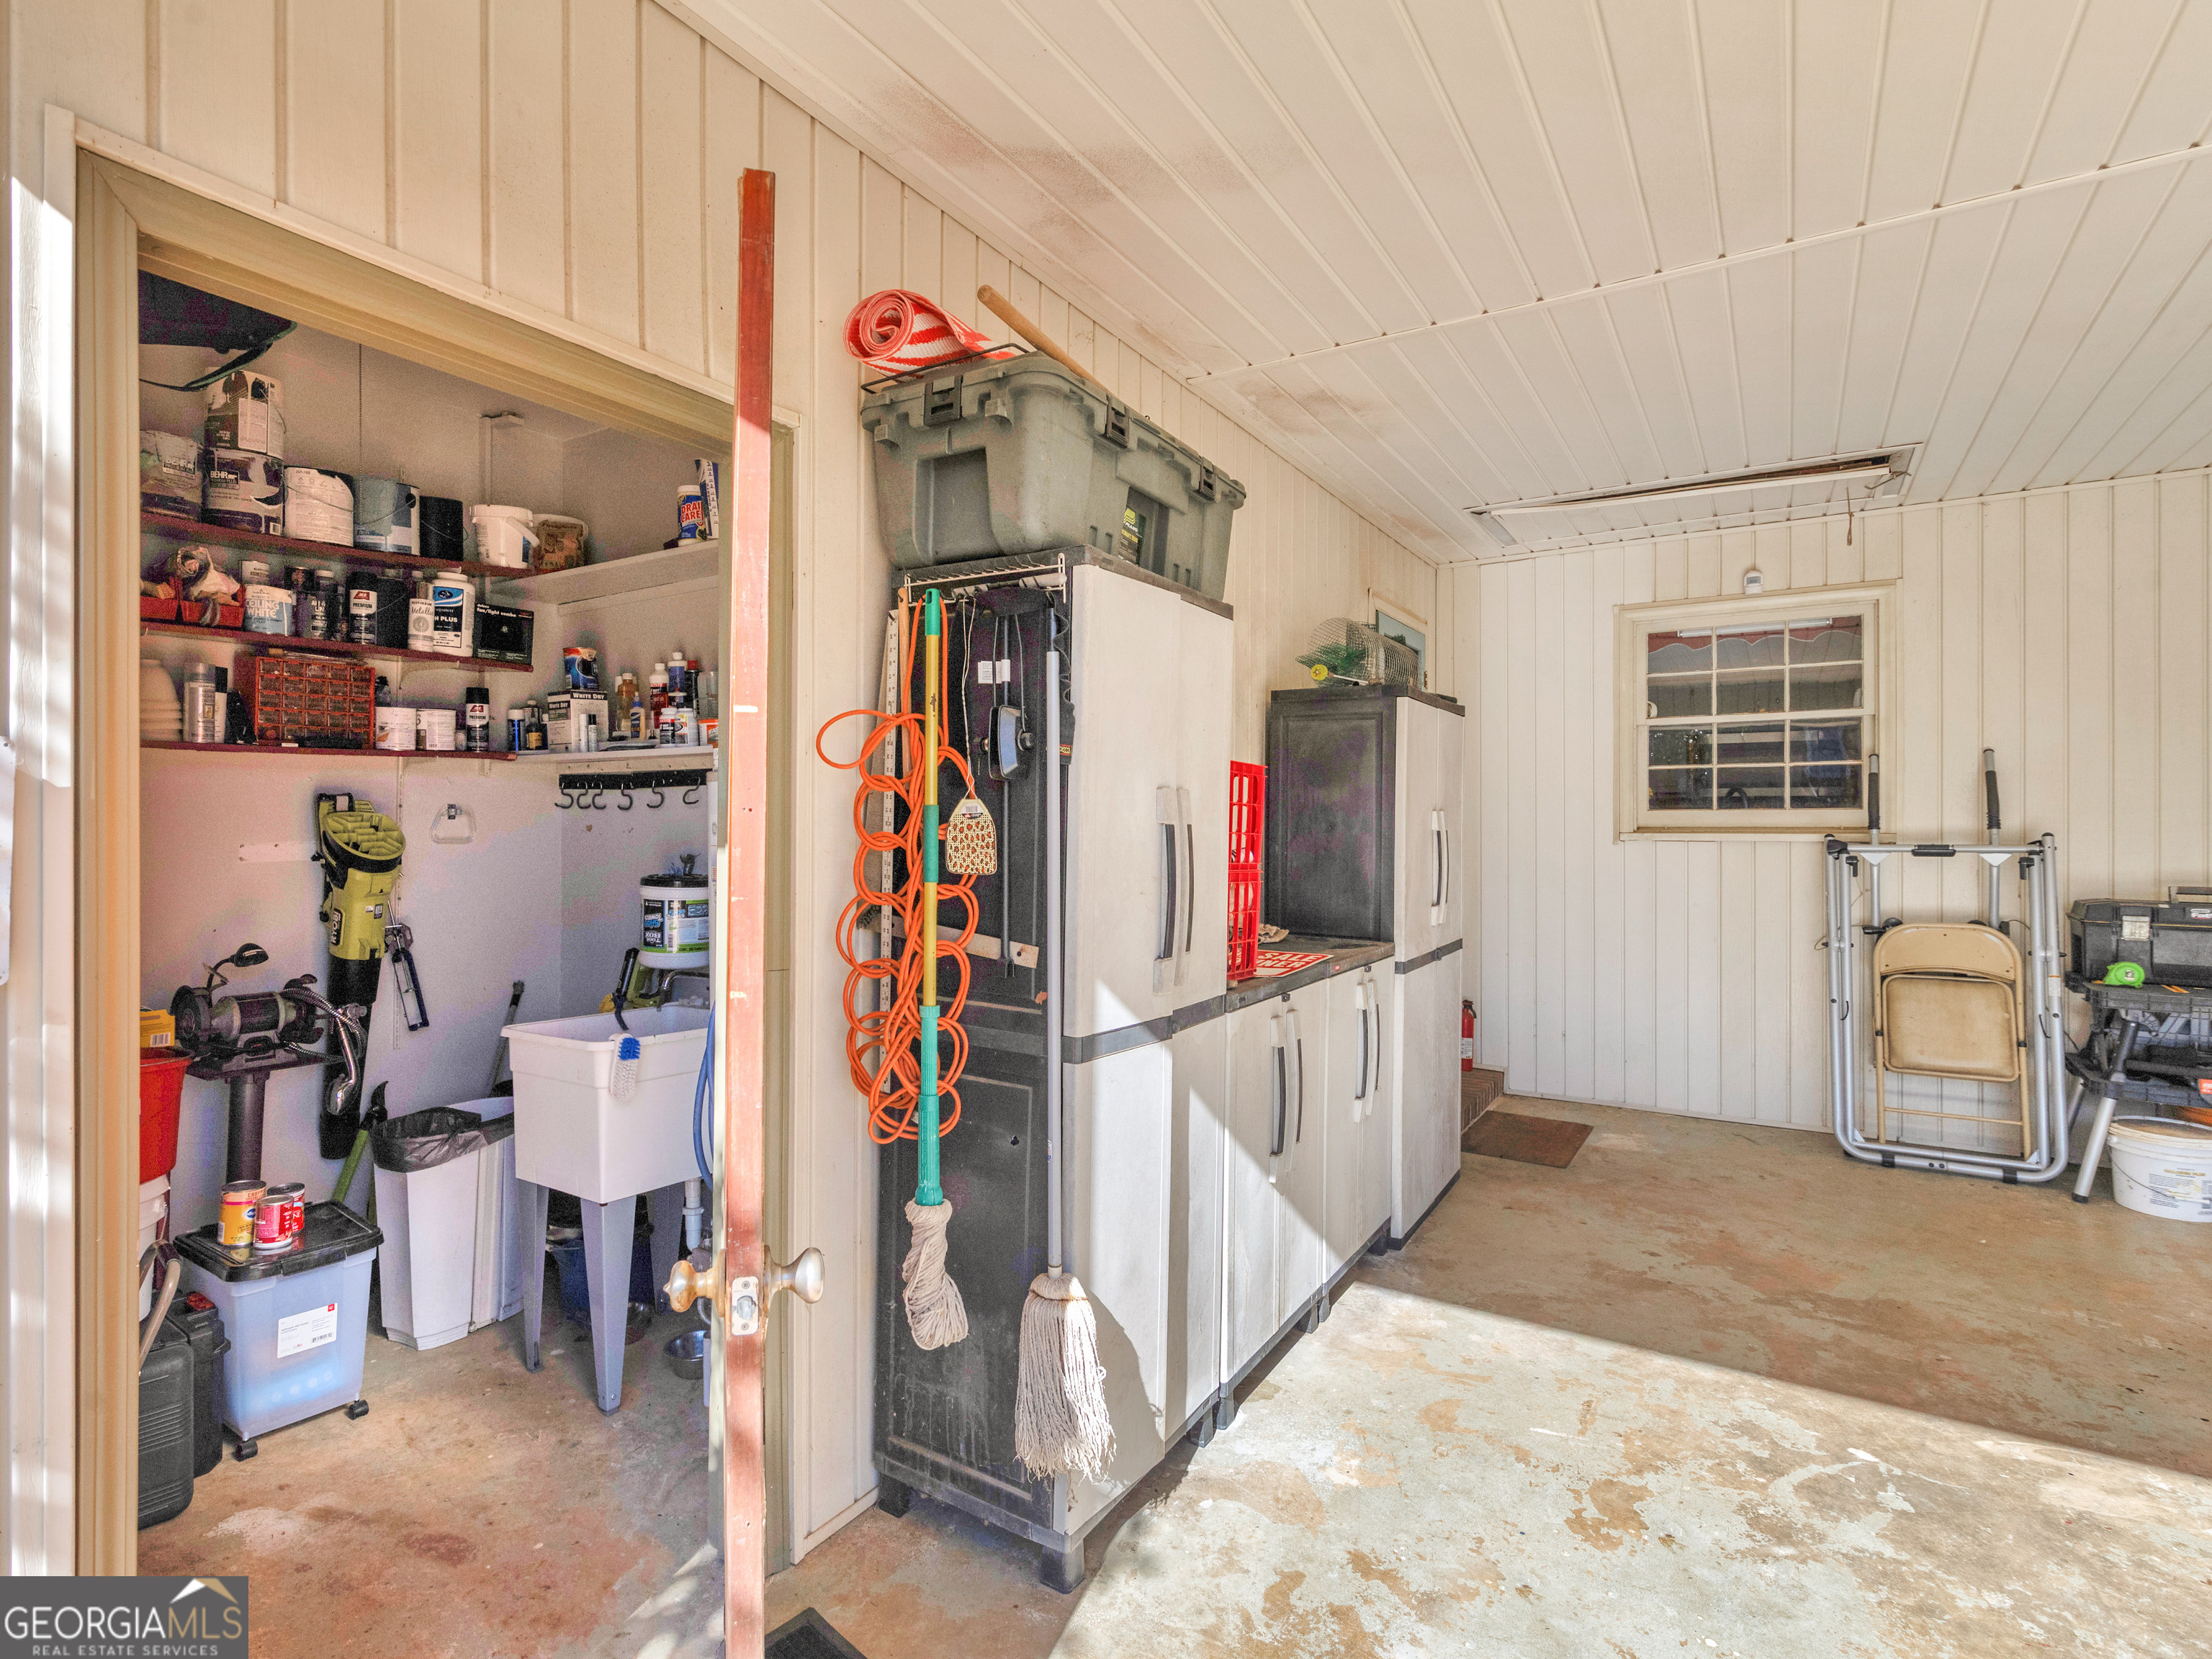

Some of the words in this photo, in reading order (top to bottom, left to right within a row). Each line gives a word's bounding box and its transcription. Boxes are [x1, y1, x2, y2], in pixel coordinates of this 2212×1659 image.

[210, 470, 228, 479] BEHR
[680, 511, 701, 523] CARE
[246, 599, 280, 610] CEILING
[247, 607, 277, 619] WHITE
[477, 607, 500, 616] fan/light
[1257, 953, 1322, 961] SALE
